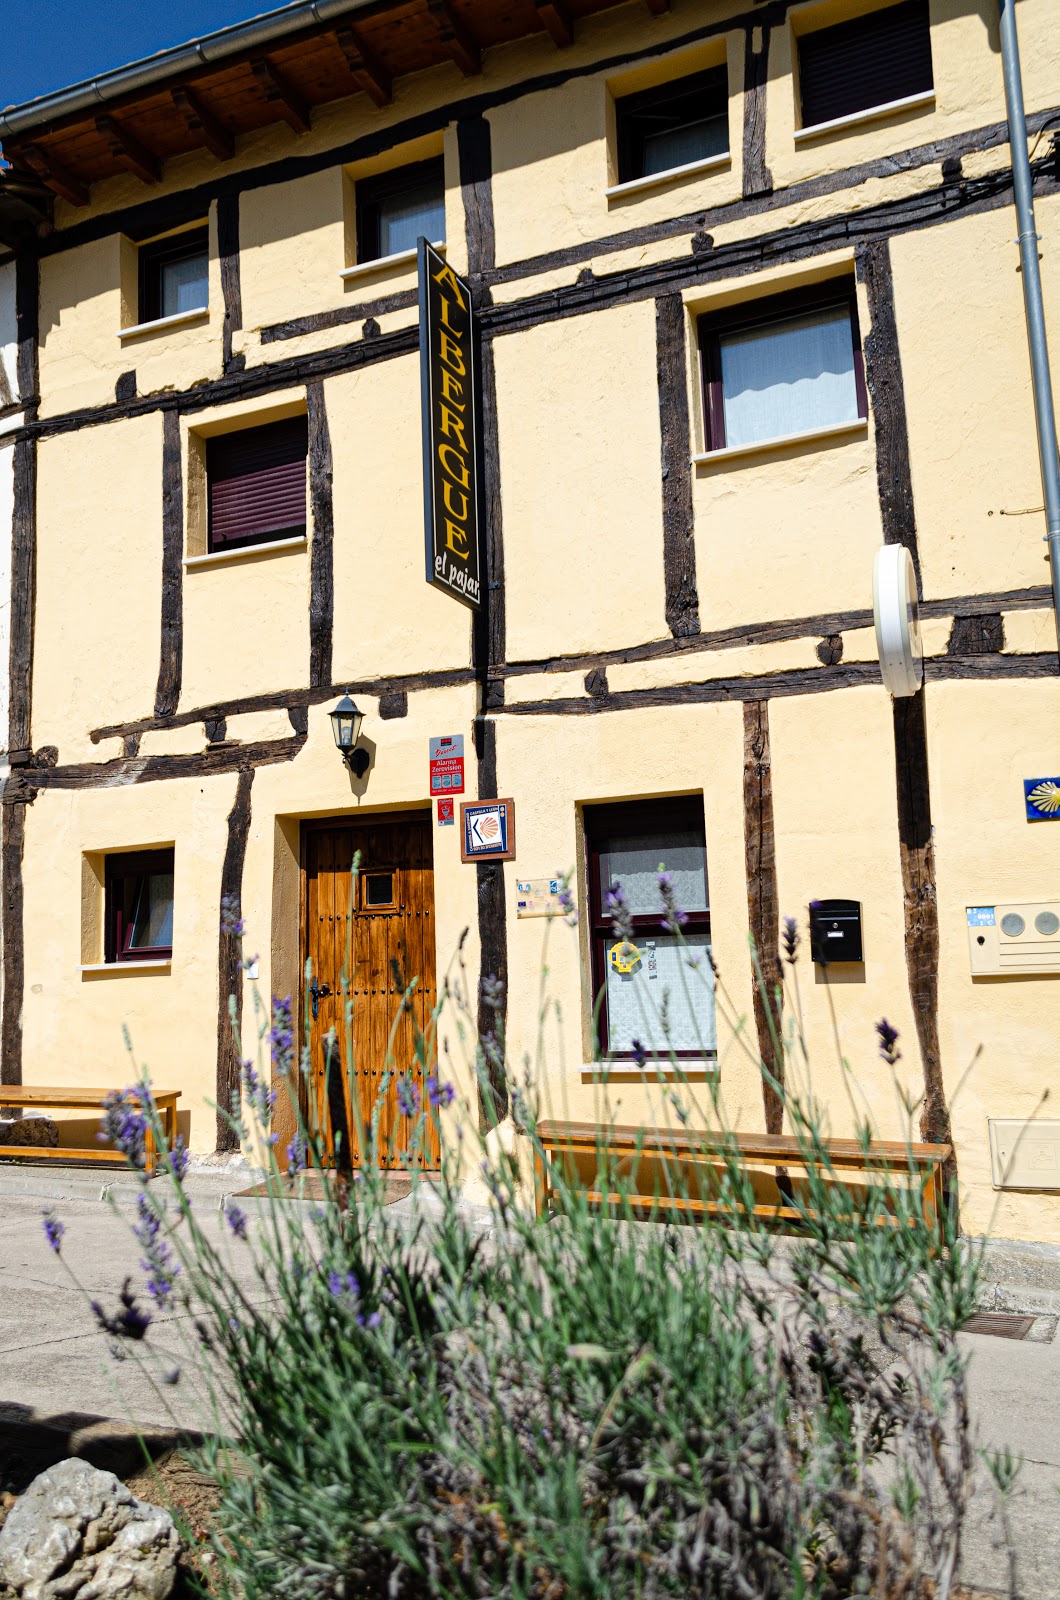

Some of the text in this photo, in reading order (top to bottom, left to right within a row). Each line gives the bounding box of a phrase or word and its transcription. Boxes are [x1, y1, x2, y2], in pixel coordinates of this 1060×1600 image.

[431, 264, 471, 560] ALBERGUE
[435, 551, 479, 596] el pajar
[432, 764, 462, 773] Zerovision
